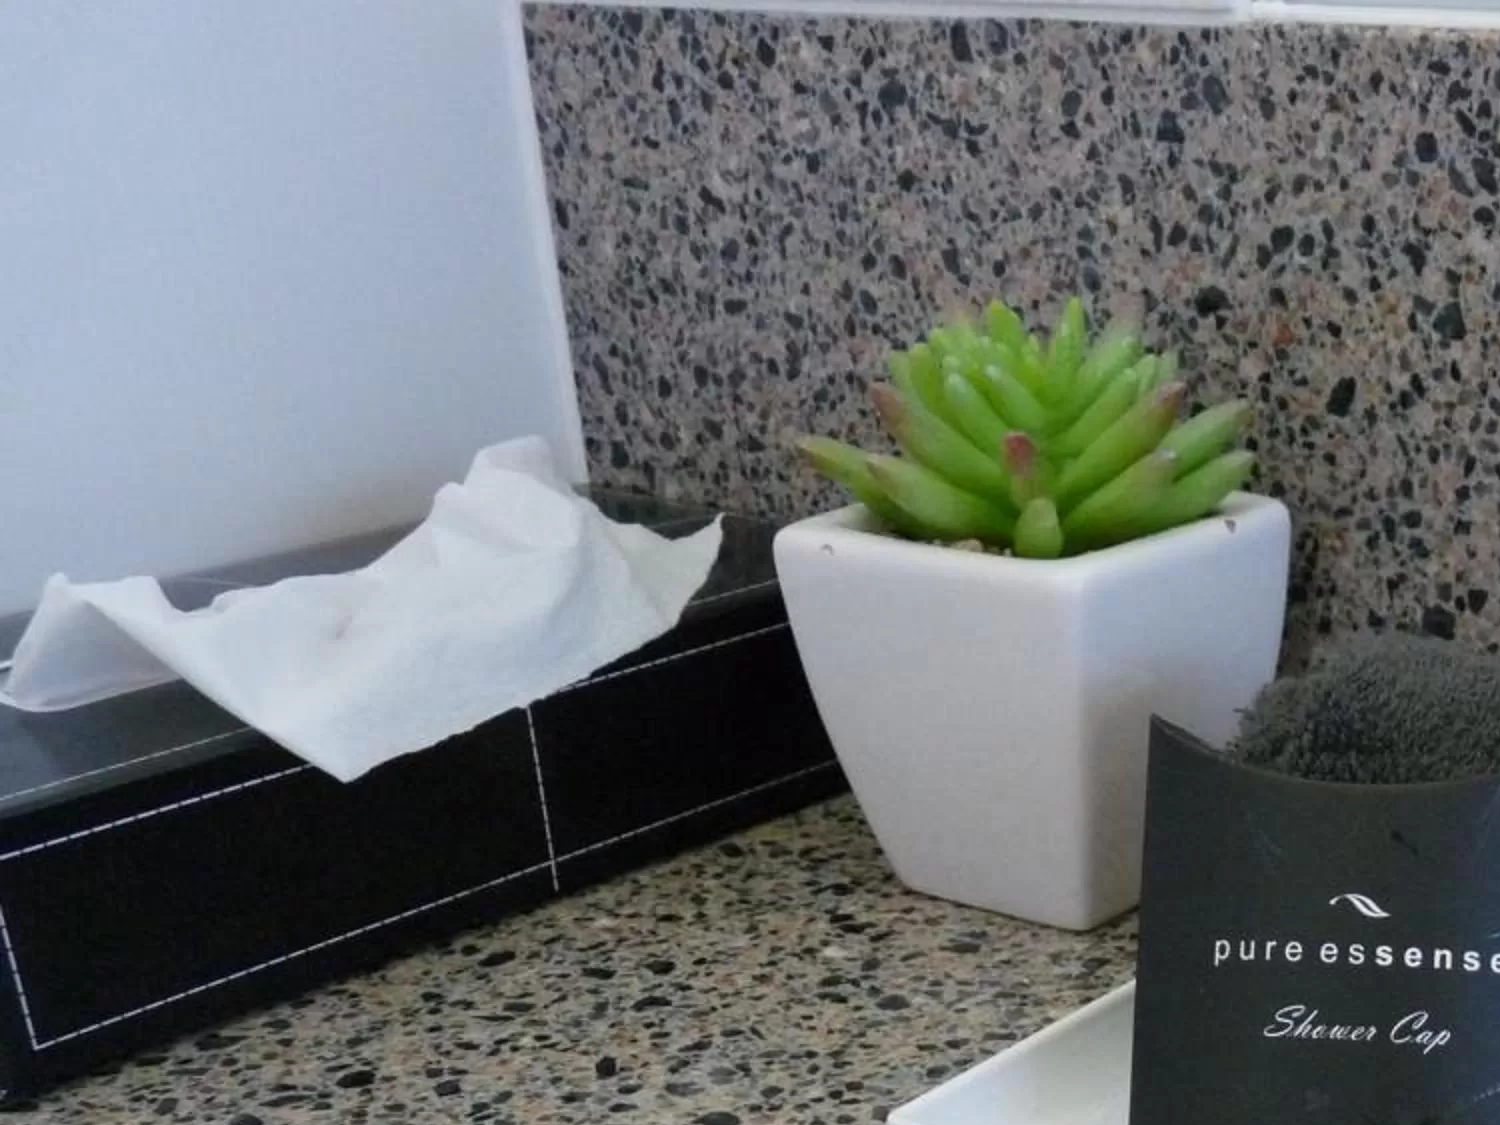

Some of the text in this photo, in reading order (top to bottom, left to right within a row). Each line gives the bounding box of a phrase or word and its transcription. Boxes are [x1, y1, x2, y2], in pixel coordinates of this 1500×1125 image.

[1214, 936, 1303, 966] pure
[1264, 1005, 1451, 1054] Shower Cap
